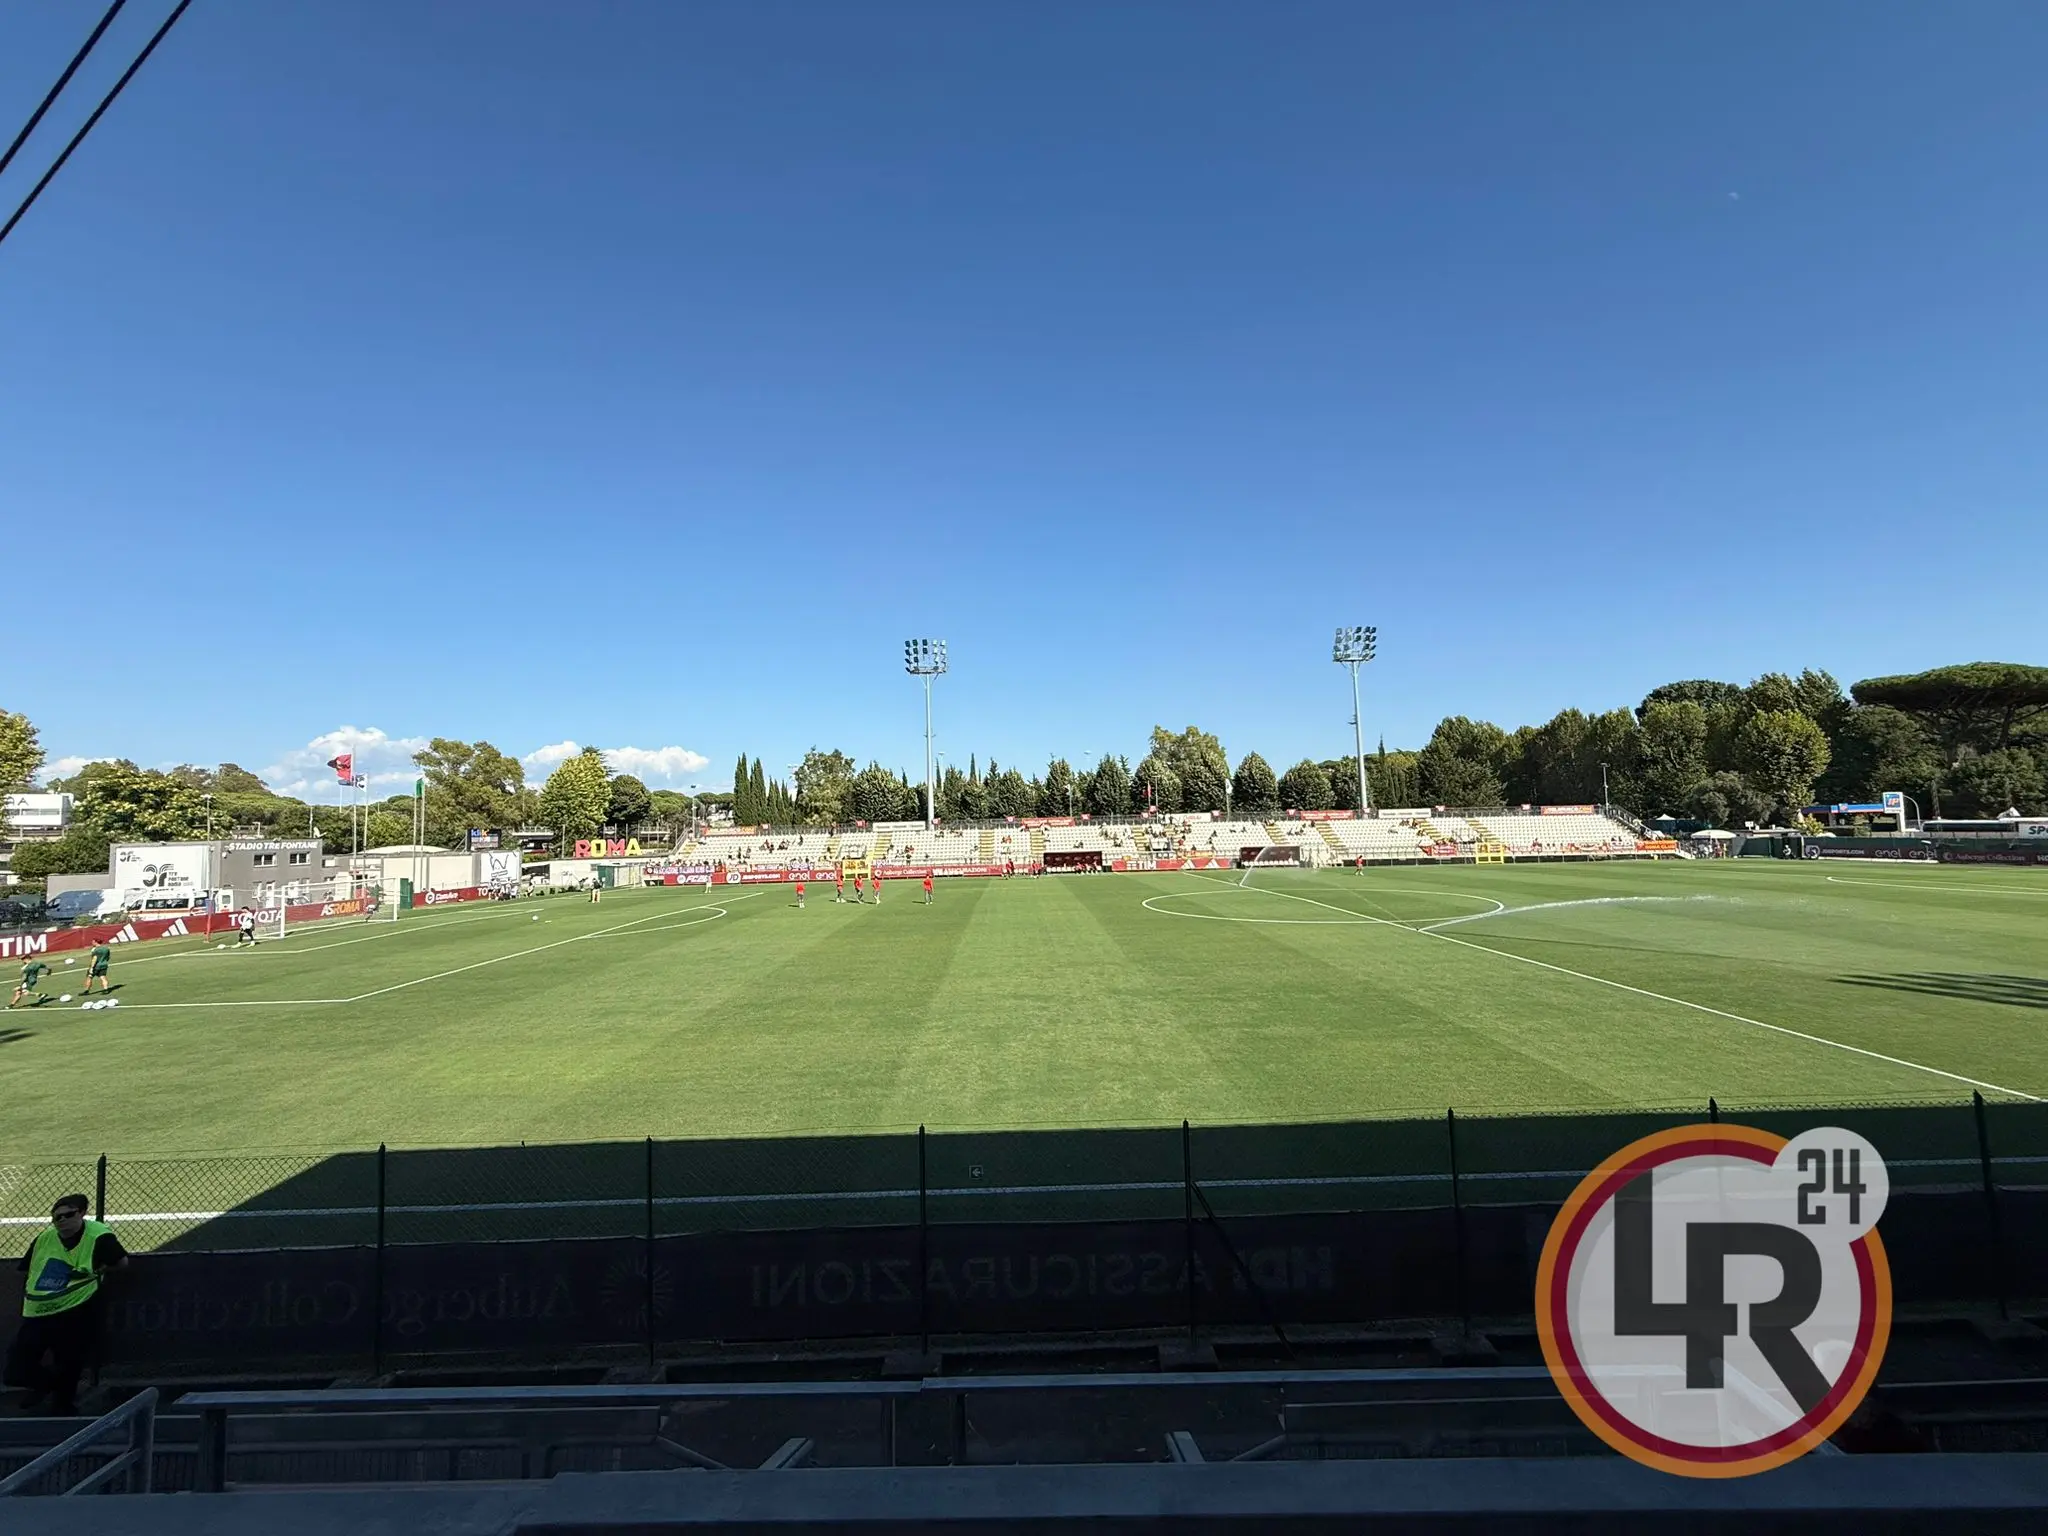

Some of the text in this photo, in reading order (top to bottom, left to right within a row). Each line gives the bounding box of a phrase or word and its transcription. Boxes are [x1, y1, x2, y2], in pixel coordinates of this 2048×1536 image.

[2028, 825, 2048, 835] SP
[228, 841, 318, 851] STADIO TRE FONTANE
[575, 838, 641, 857] ROMA
[1875, 848, 1902, 858] enel
[1138, 860, 1157, 869] TIM
[789, 871, 809, 879] enel
[0, 934, 47, 958] TIM
